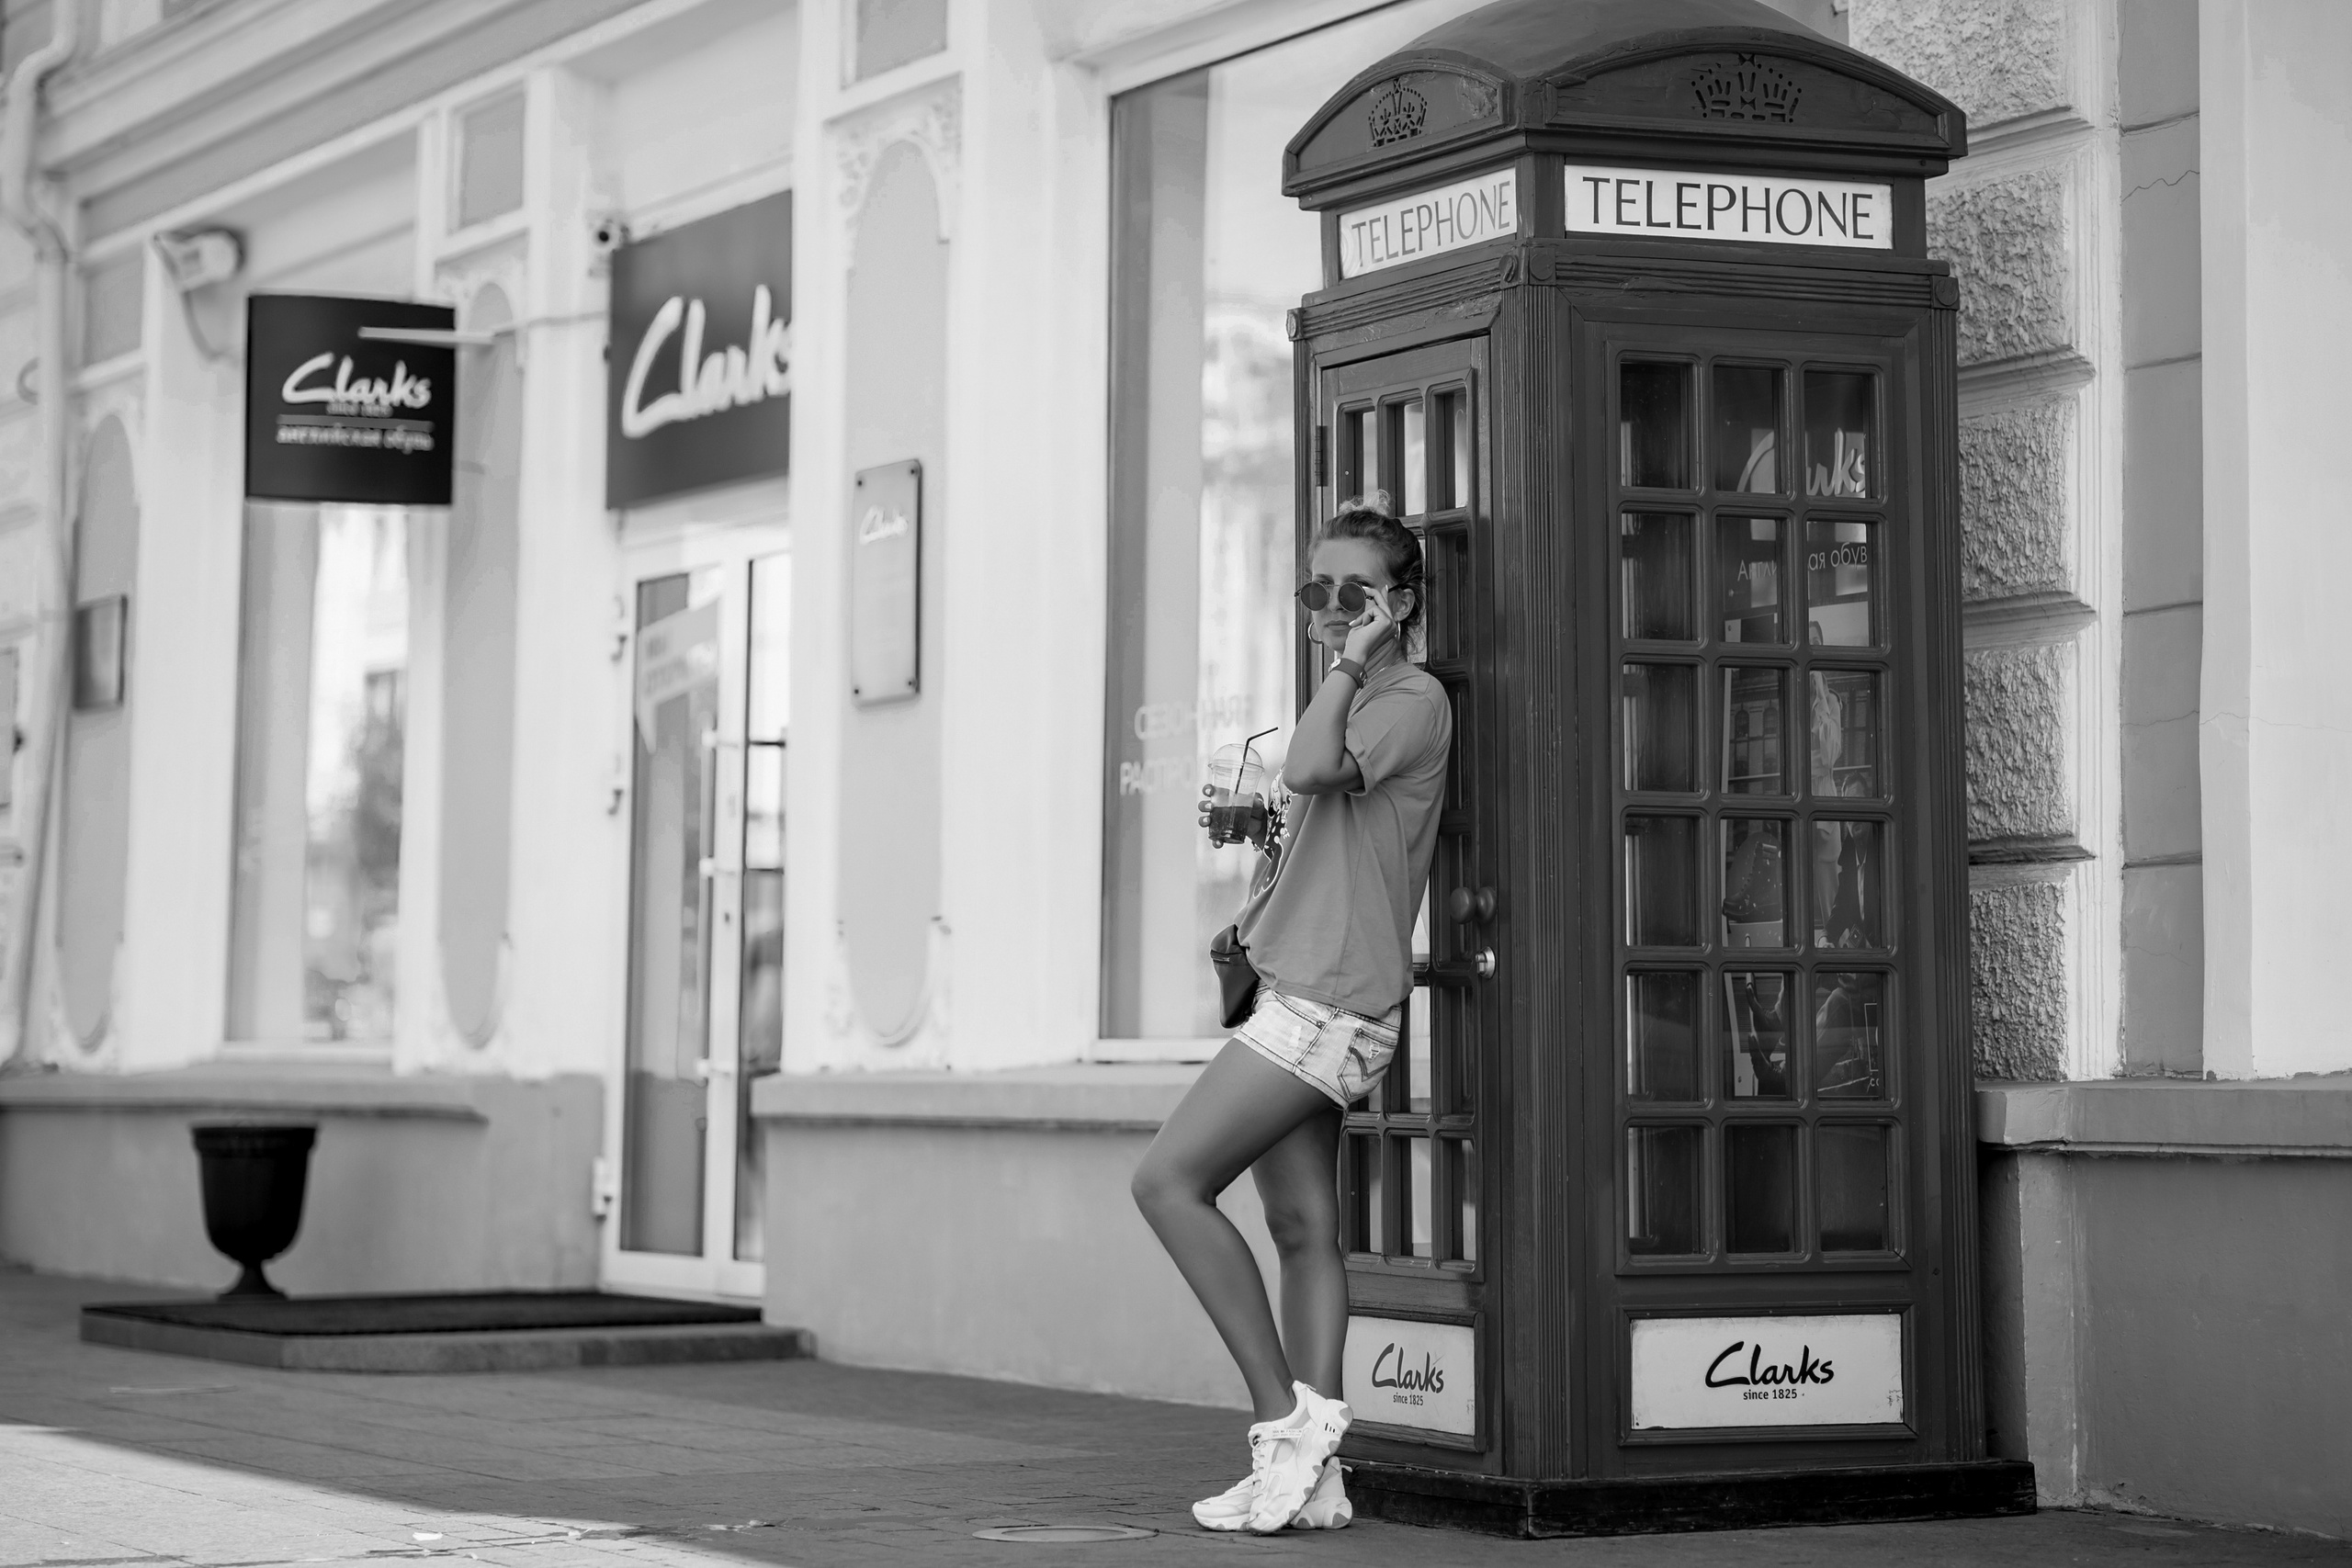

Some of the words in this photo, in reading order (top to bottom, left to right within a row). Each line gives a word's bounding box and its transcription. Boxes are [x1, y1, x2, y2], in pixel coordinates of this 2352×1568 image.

[1351, 181, 1510, 267] TELEPHONE
[1582, 175, 1874, 240] TELEPHONE
[282, 351, 431, 409] Clarks
[1830, 541, 1868, 571] обув
[1372, 1343, 1444, 1393] Clarks
[1705, 1341, 1835, 1388] Clarks
[1393, 1393, 1408, 1404] since
[1409, 1394, 1423, 1406] 1825
[1744, 1389, 1769, 1400] since
[1772, 1388, 1797, 1399] 1825
